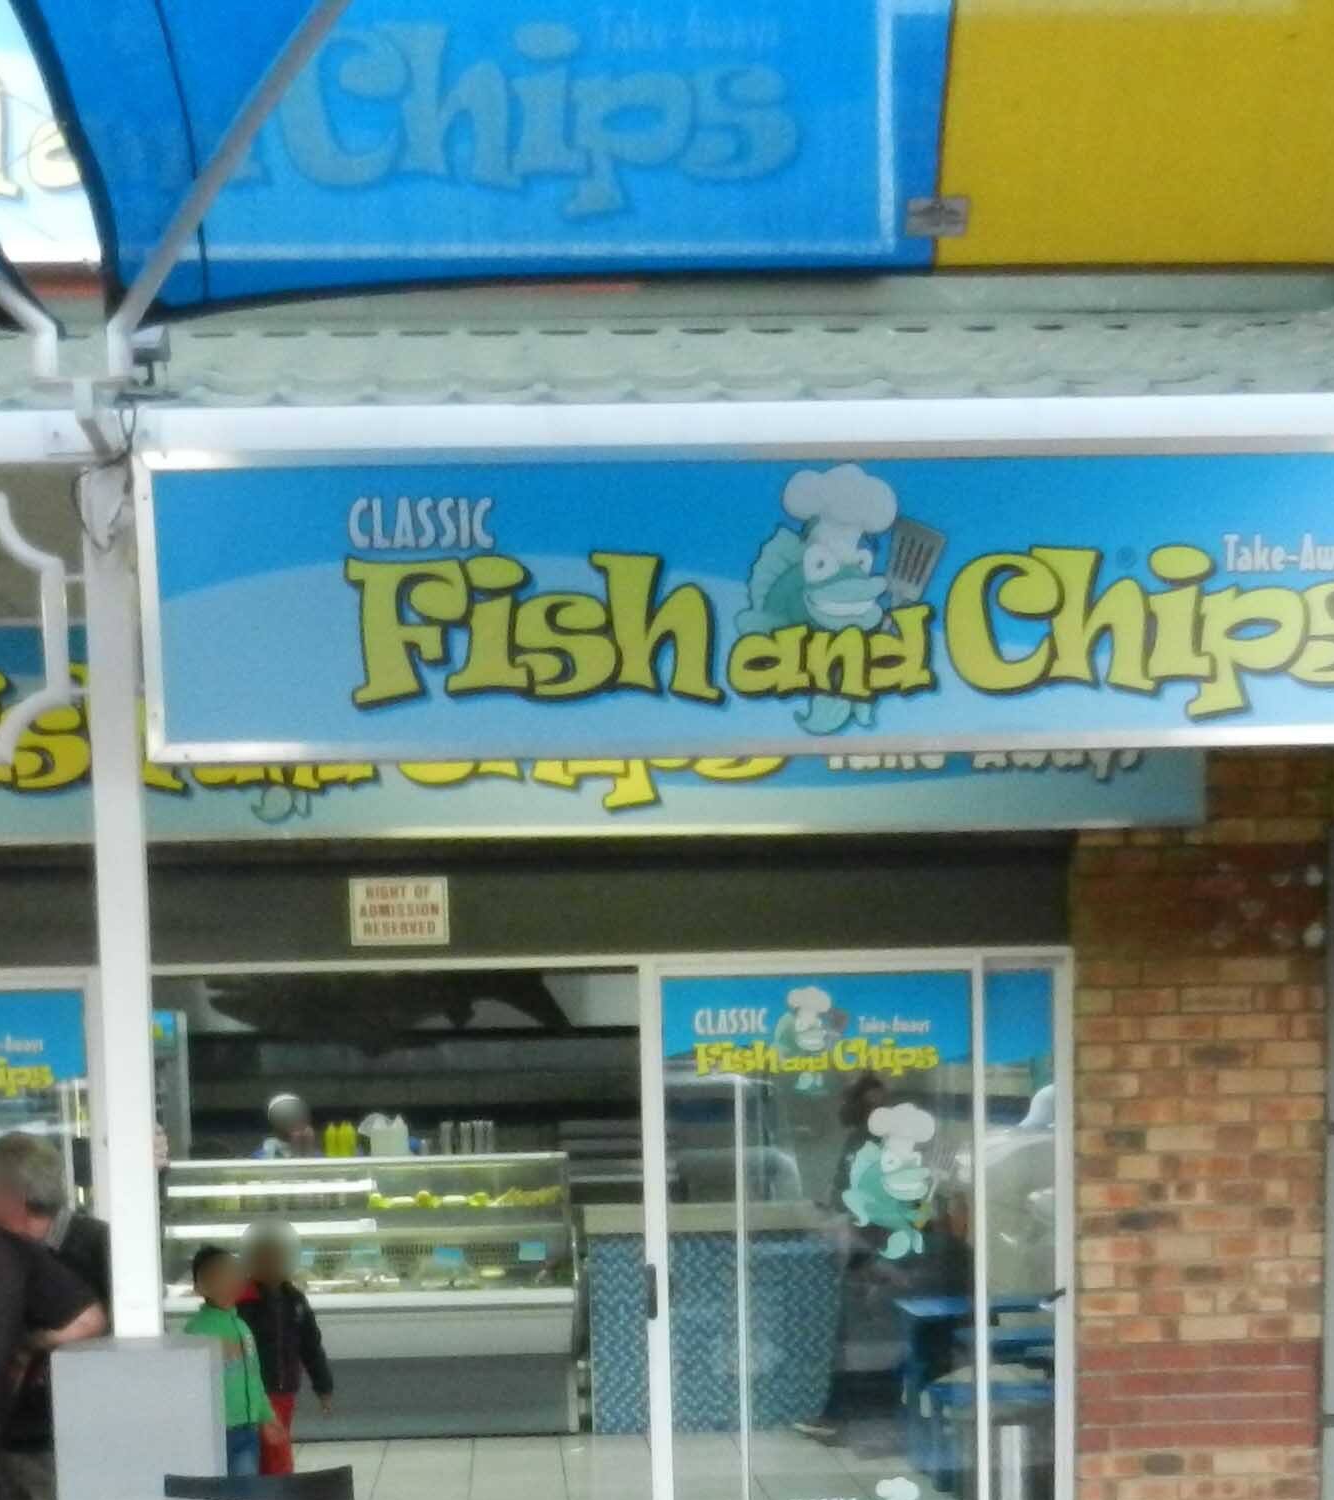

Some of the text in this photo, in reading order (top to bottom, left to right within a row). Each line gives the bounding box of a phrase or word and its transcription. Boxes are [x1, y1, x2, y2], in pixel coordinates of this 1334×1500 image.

[278, 20, 805, 219] Chips
[347, 496, 495, 551] CLASSIC
[344, 549, 727, 709] Fish
[727, 602, 938, 703] and
[359, 903, 440, 918] ADMISSION
[363, 921, 436, 937] RESERVED
[694, 1007, 768, 1036] CLASSIC
[693, 1036, 940, 1077] Fish and Chips
